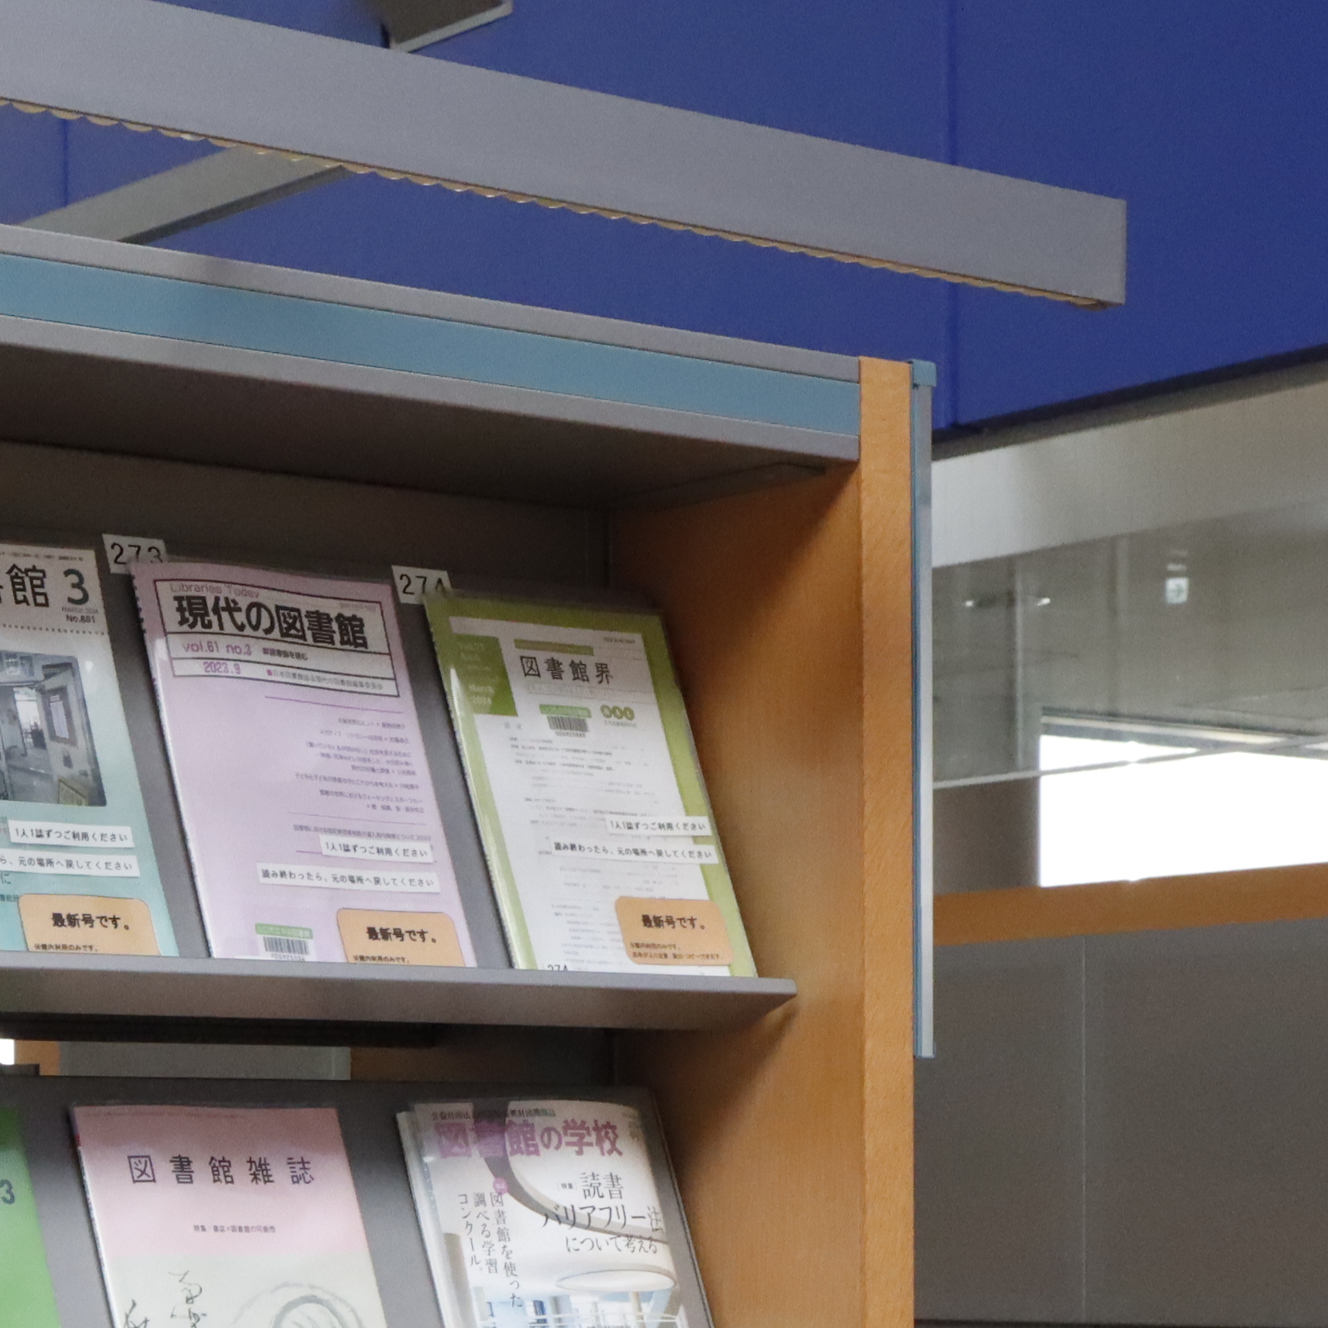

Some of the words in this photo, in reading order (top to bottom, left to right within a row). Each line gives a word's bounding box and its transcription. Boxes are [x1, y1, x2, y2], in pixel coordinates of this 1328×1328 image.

[62, 568, 91, 605] 3
[173, 594, 369, 650] 現代の図書館
[519, 655, 614, 685] 図書館界
[14, 826, 129, 843] 1人1誌ずつご利用ください
[610, 820, 706, 832] 1人1誌ずつご利用ください
[324, 841, 428, 858] 1人1誌ずつご利用ください
[554, 841, 713, 859] 読み終わったら、元の場所へ戻してください
[261, 868, 435, 887] 読み終わったら、元の場所へ戻してください
[51, 912, 130, 932] 最新号です。
[641, 914, 706, 930] 最新号です。
[366, 926, 438, 944] 最新号です。
[127, 1154, 315, 1186] 図書館雑誌
[580, 1171, 624, 1200] 読書
[541, 1204, 664, 1232] バリアフリー法
[474, 1192, 498, 1274] 調べる学習
[490, 1192, 522, 1308] 図書館を使った
[565, 1234, 658, 1255] について考える
